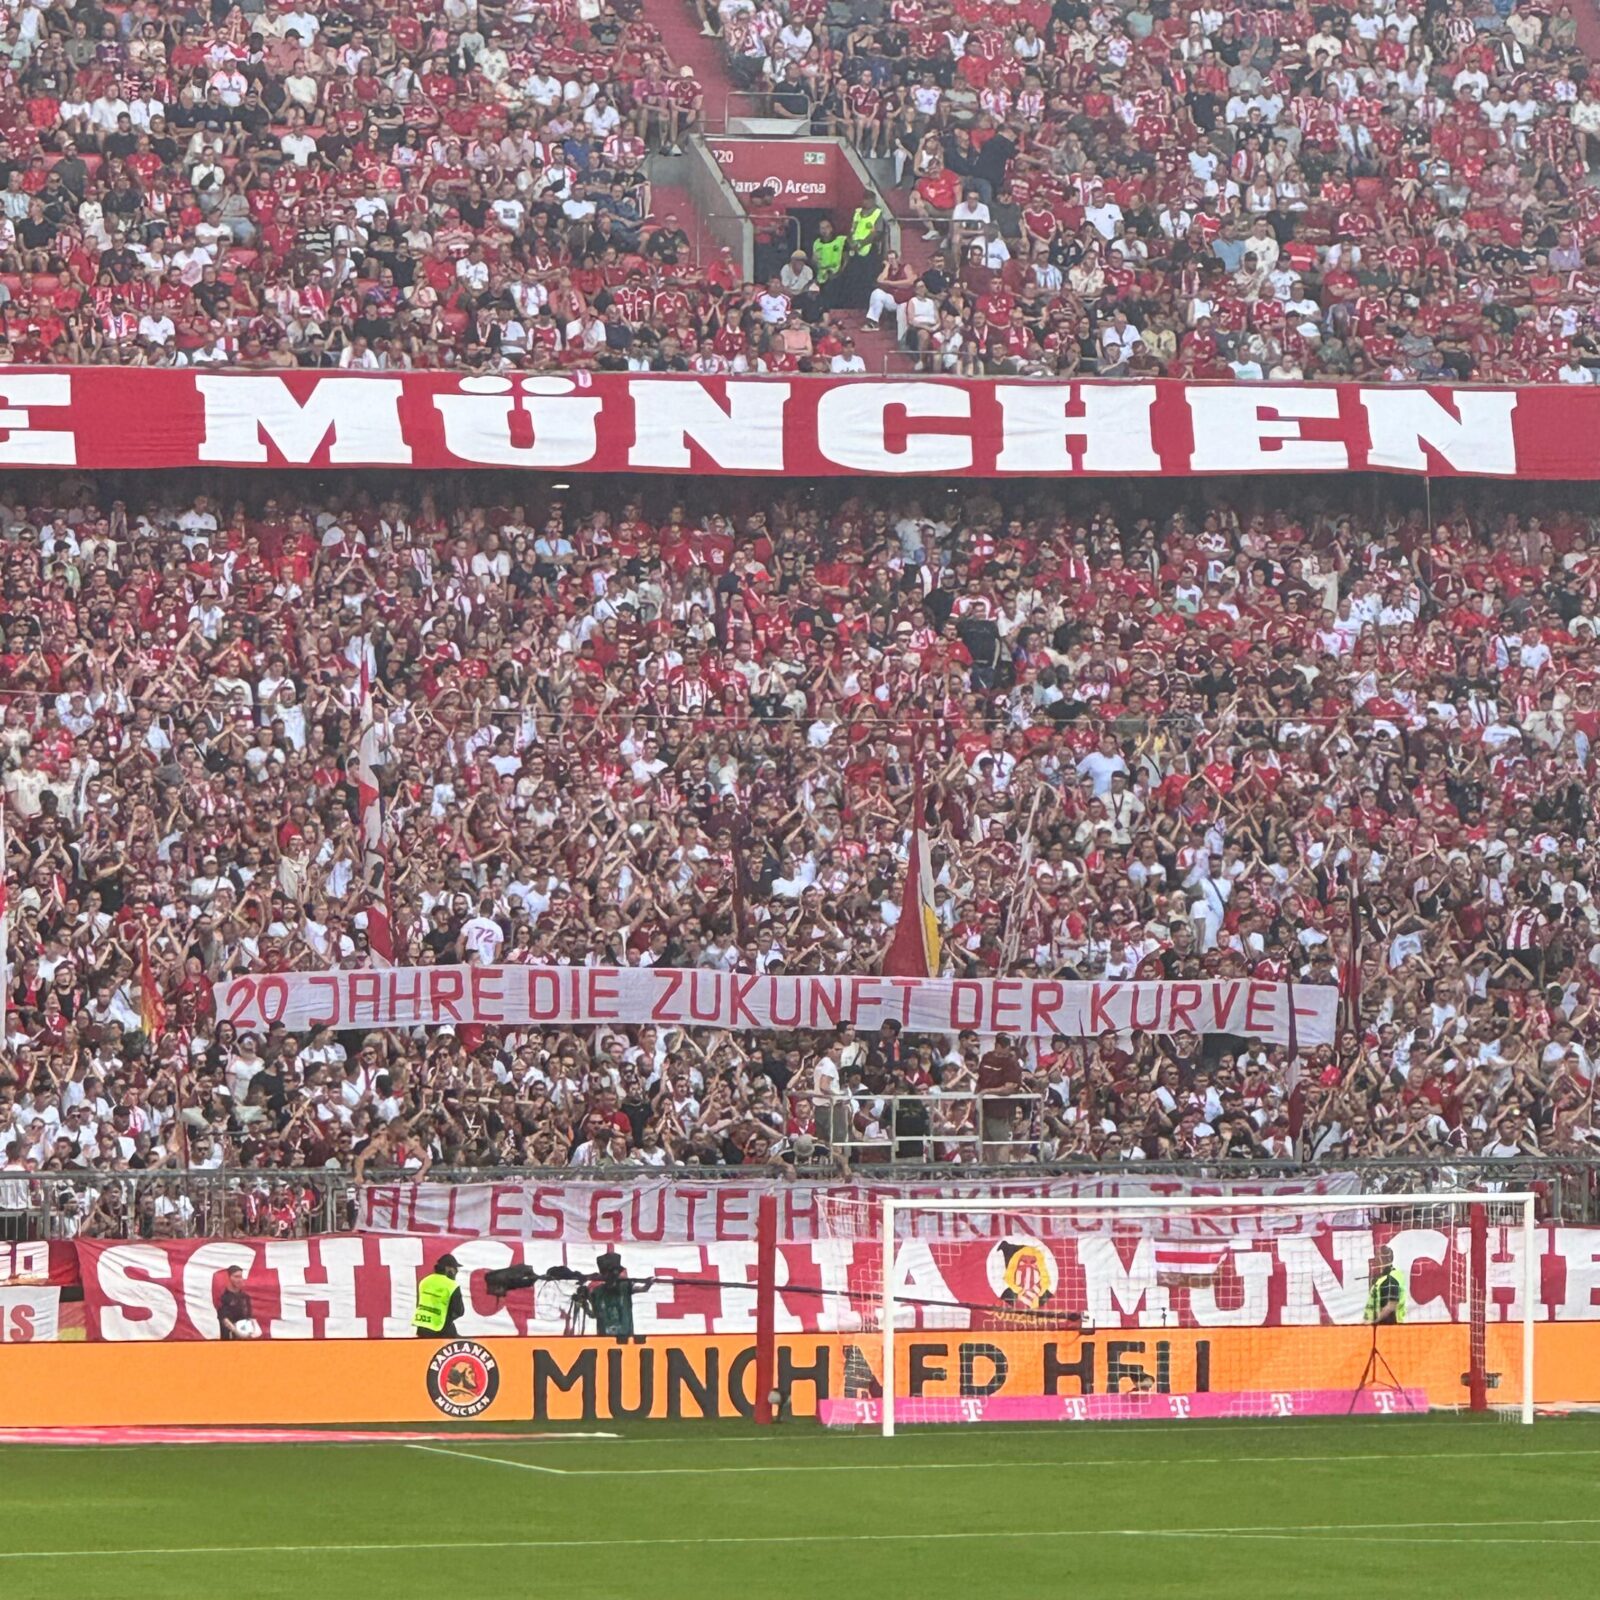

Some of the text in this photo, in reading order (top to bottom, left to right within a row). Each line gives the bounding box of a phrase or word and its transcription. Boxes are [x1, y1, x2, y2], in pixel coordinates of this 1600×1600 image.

[785, 180, 826, 194] Arena
[195, 374, 1518, 477] MÜNCHEN
[474, 926, 495, 943] 72
[225, 975, 289, 1029] 20
[309, 968, 505, 1027] JAHRE
[528, 968, 620, 1020] DIE
[650, 968, 926, 1029] ZUKUNFT
[949, 978, 1066, 1033] DER
[365, 1184, 565, 1240] ALLES
[588, 1186, 749, 1242] GUTE
[430, 1342, 496, 1372] PAULANER
